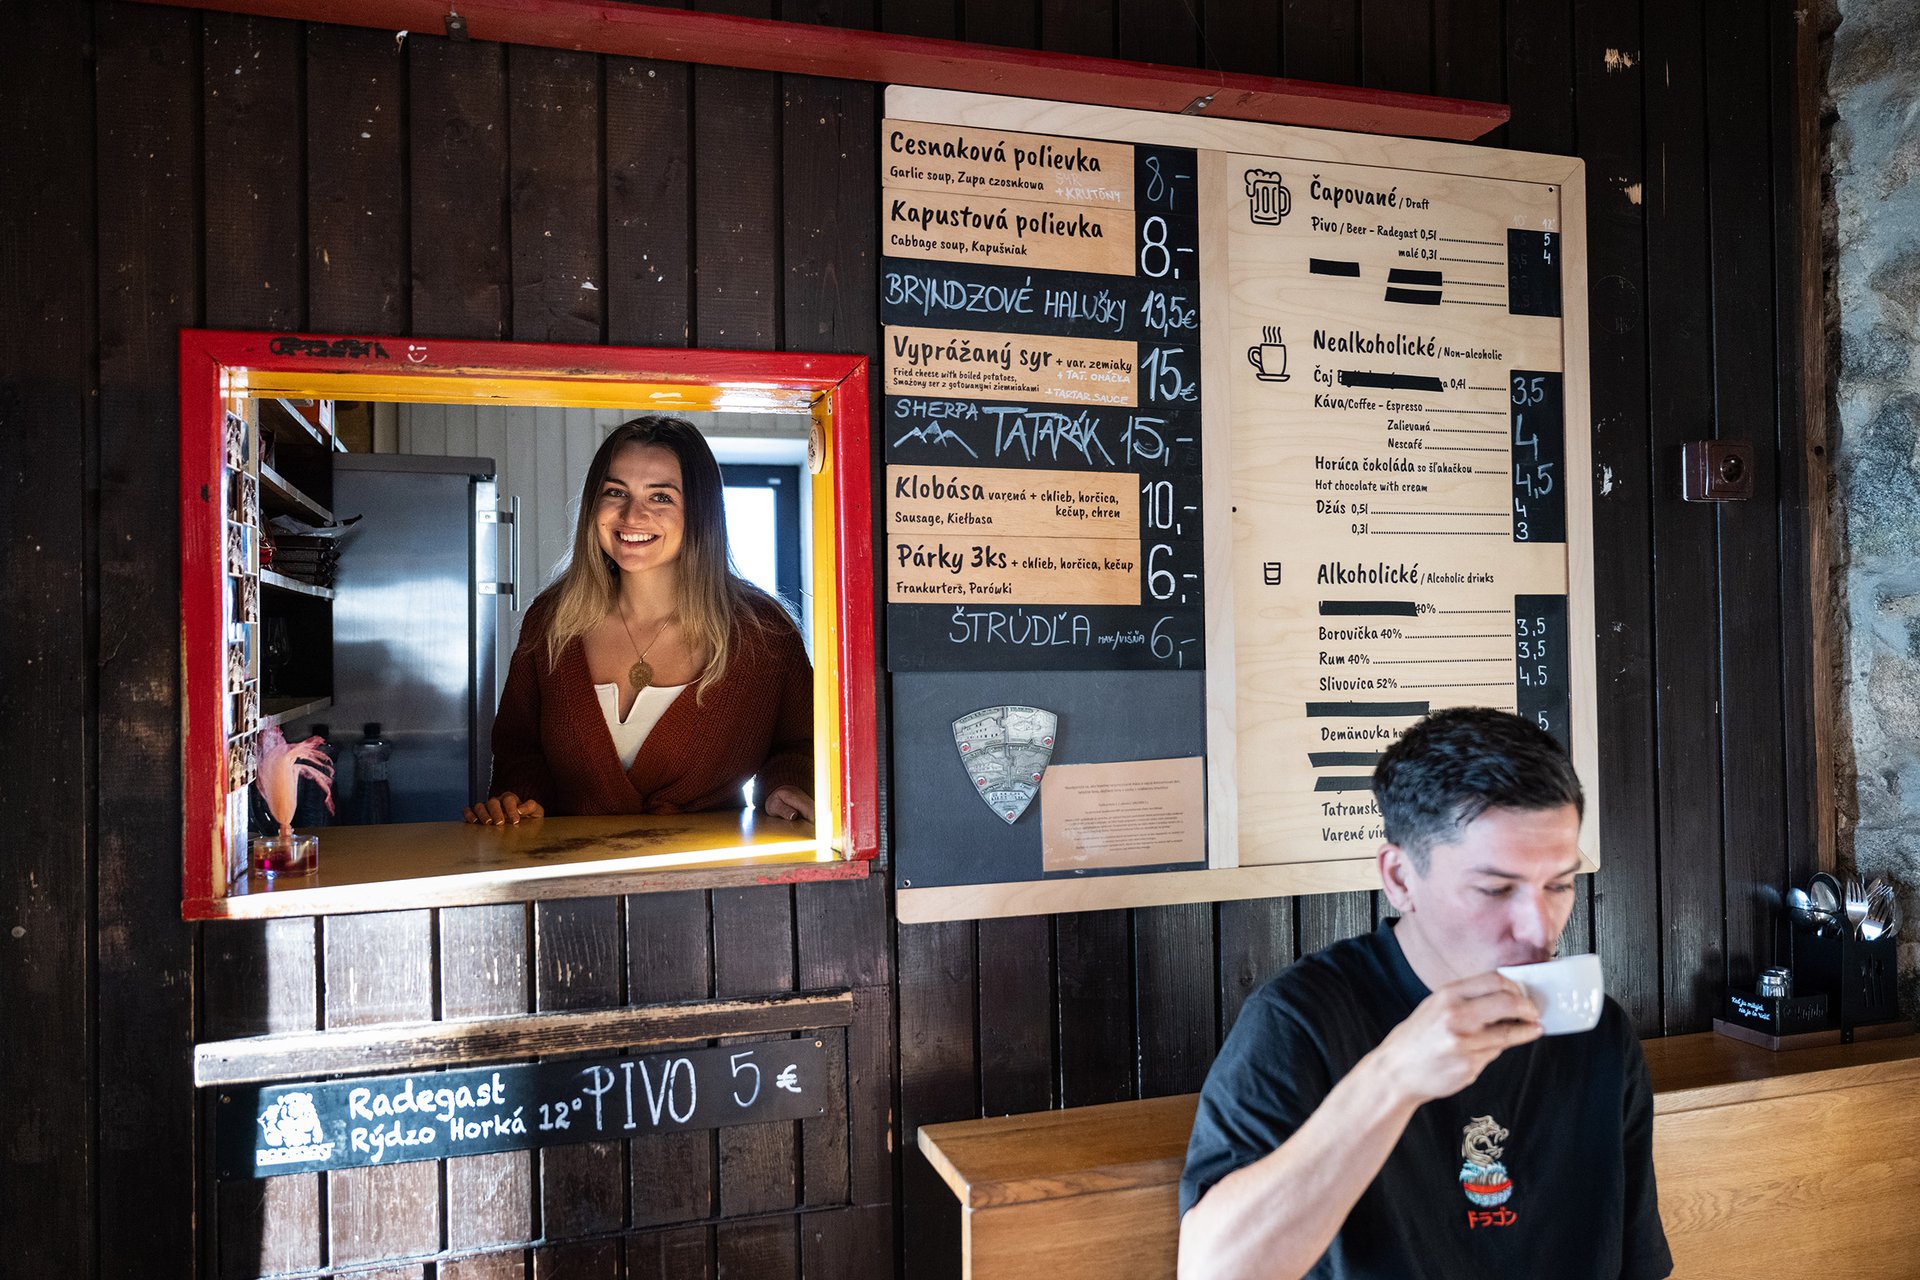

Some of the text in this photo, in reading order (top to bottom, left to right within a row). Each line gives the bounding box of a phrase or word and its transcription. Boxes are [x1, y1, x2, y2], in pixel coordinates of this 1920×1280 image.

[890, 131, 1101, 172] Cesnaková polievka
[890, 166, 1044, 190] Garlic soup, Zupa czosnkowa
[1310, 174, 1398, 209] Čapované
[1406, 197, 1430, 210] Draft
[891, 199, 1103, 238] Kapustová polievka
[1311, 216, 1338, 234] Pivo
[1346, 223, 1367, 235] Beer
[1377, 225, 1418, 241] Radegast
[891, 233, 1028, 256] Cabbage soup, Kapušniak
[1543, 233, 1551, 247] 5
[1398, 248, 1419, 260] malé
[1543, 249, 1551, 265] 4
[885, 272, 1034, 317] BRYNDZOVÉ
[1044, 288, 1127, 333] HALUŠKY
[893, 335, 1012, 371] Vyprážaný
[1019, 350, 1053, 372] syr
[1066, 359, 1086, 369] var.
[1088, 358, 1133, 374] zemiaky
[1313, 329, 1435, 358] Nealkoholické
[1443, 346, 1503, 361] Non-alcoholic
[893, 367, 1017, 383] Fried cheese with boiled potatoes,
[893, 377, 926, 388] Smażony
[928, 380, 940, 388] ser
[948, 381, 992, 391] gotowanymi
[993, 383, 1040, 392] ziemniakami
[1313, 365, 1333, 387] Čaj
[1386, 400, 1423, 414] Espresso
[894, 399, 979, 421] SHERPA
[982, 405, 1115, 466] TATARÁK
[1387, 419, 1431, 433] Zalievaná
[1387, 438, 1423, 451] Nescafé
[1514, 413, 1539, 461] 4
[1315, 456, 1472, 475] Horúca čokoláda so šľahačkou
[895, 475, 985, 501] Klobása
[988, 487, 1026, 502] varená
[1040, 490, 1076, 505] chlieb,
[1078, 492, 1120, 507] horčica,
[1315, 479, 1428, 493] Hot chocolate with cream
[1056, 506, 1121, 520] kečup, chren
[1316, 499, 1346, 515] Džús
[1515, 497, 1527, 518] 4
[895, 511, 993, 527] Sausage, Kiełbasa
[1515, 521, 1529, 540] 3
[896, 543, 964, 575] Párky
[970, 546, 1008, 569] 3ks
[1021, 556, 1057, 571] chlieb,
[1060, 557, 1101, 571] horčica,
[1103, 557, 1134, 572] kečup
[1317, 562, 1419, 585] Alkoholické
[1427, 572, 1465, 584] Alcoholic
[1467, 572, 1494, 584] drinks
[969, 582, 1013, 596] Parówki
[949, 605, 1091, 647] ŠTRÚDĽA
[1319, 625, 1402, 641] Borovička 40%
[1319, 652, 1370, 666] Rum 40%
[1319, 676, 1398, 692] Slivovica 52%
[1321, 725, 1390, 741] Demänovka
[1322, 825, 1364, 841] Varené
[350, 1074, 506, 1122] Radegast
[351, 1120, 436, 1162] Rýdzo
[450, 1106, 527, 1141] Horká
[579, 1057, 697, 1130] PIVO
[730, 1051, 760, 1107] 5
[776, 1064, 802, 1092] €
[1467, 1207, 1518, 1230] ドラゴン
